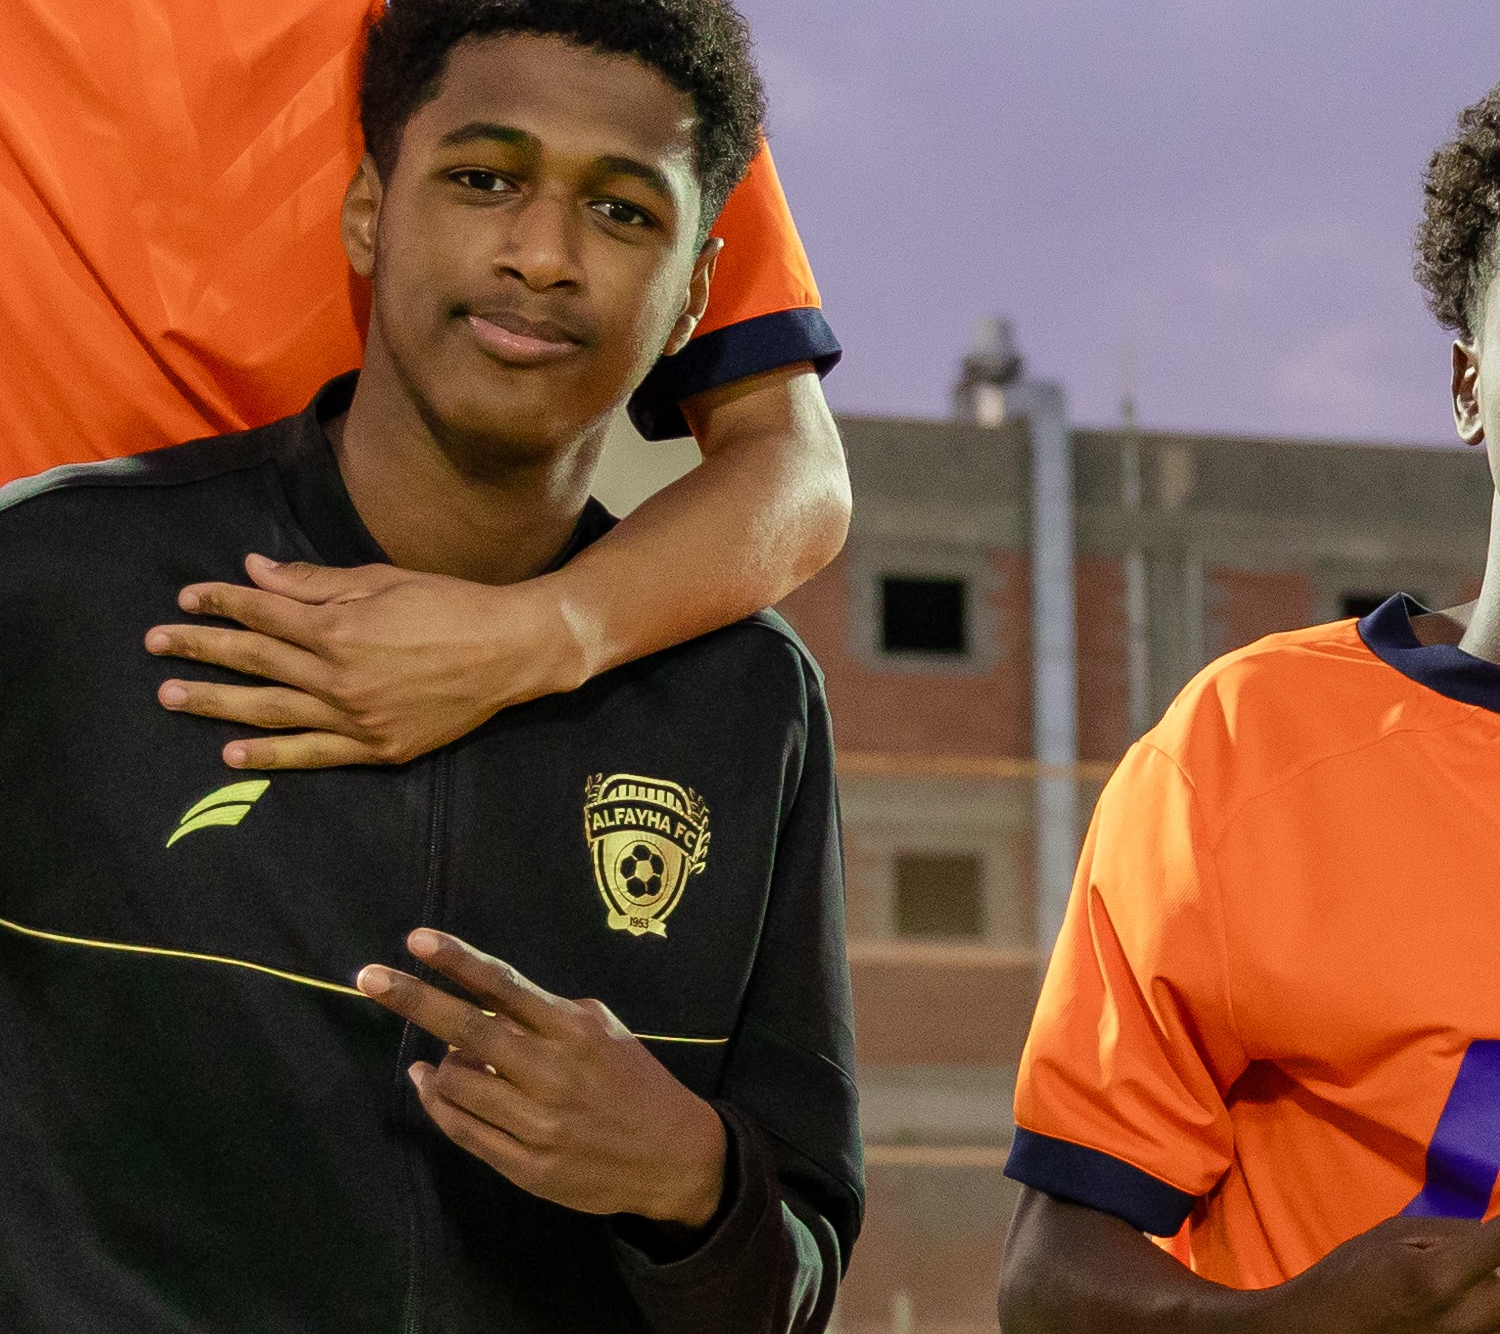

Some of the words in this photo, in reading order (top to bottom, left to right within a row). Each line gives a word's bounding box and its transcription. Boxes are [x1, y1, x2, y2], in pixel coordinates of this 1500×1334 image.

[592, 807, 671, 834] ALFAYHA
[674, 821, 697, 849] FC
[629, 916, 650, 929] 1953
